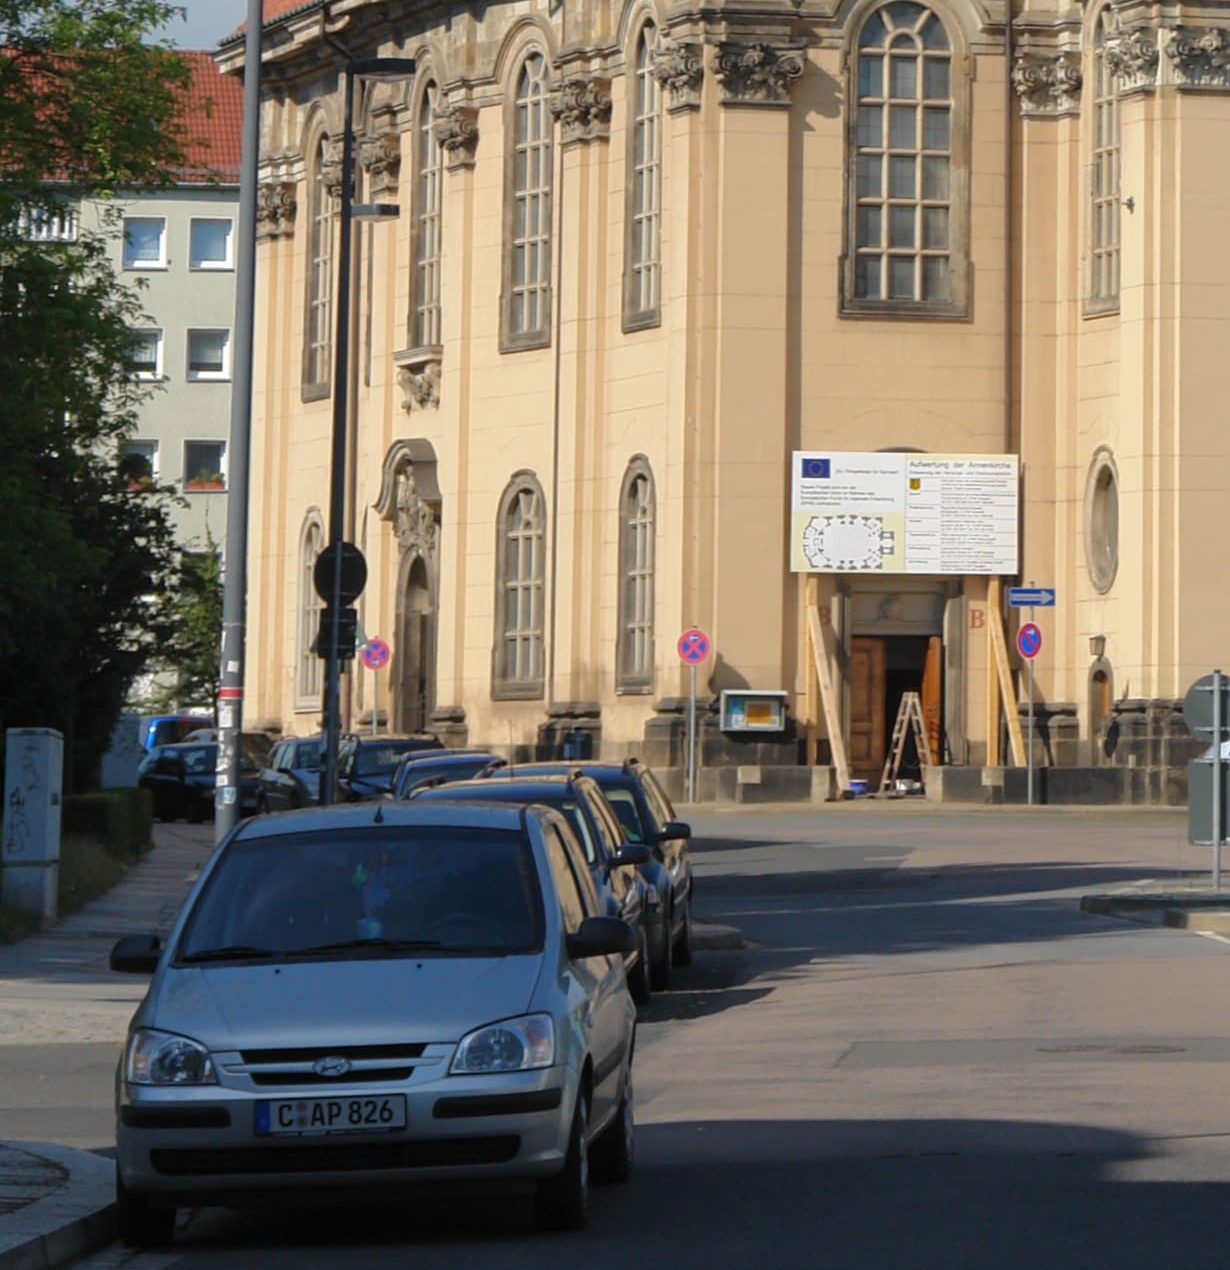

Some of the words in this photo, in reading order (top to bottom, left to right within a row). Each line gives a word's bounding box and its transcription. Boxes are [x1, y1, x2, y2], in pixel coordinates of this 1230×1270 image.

[969, 608, 986, 628] B
[278, 1104, 293, 1127] C
[311, 1102, 342, 1126] AP
[348, 1100, 393, 1125] 826
